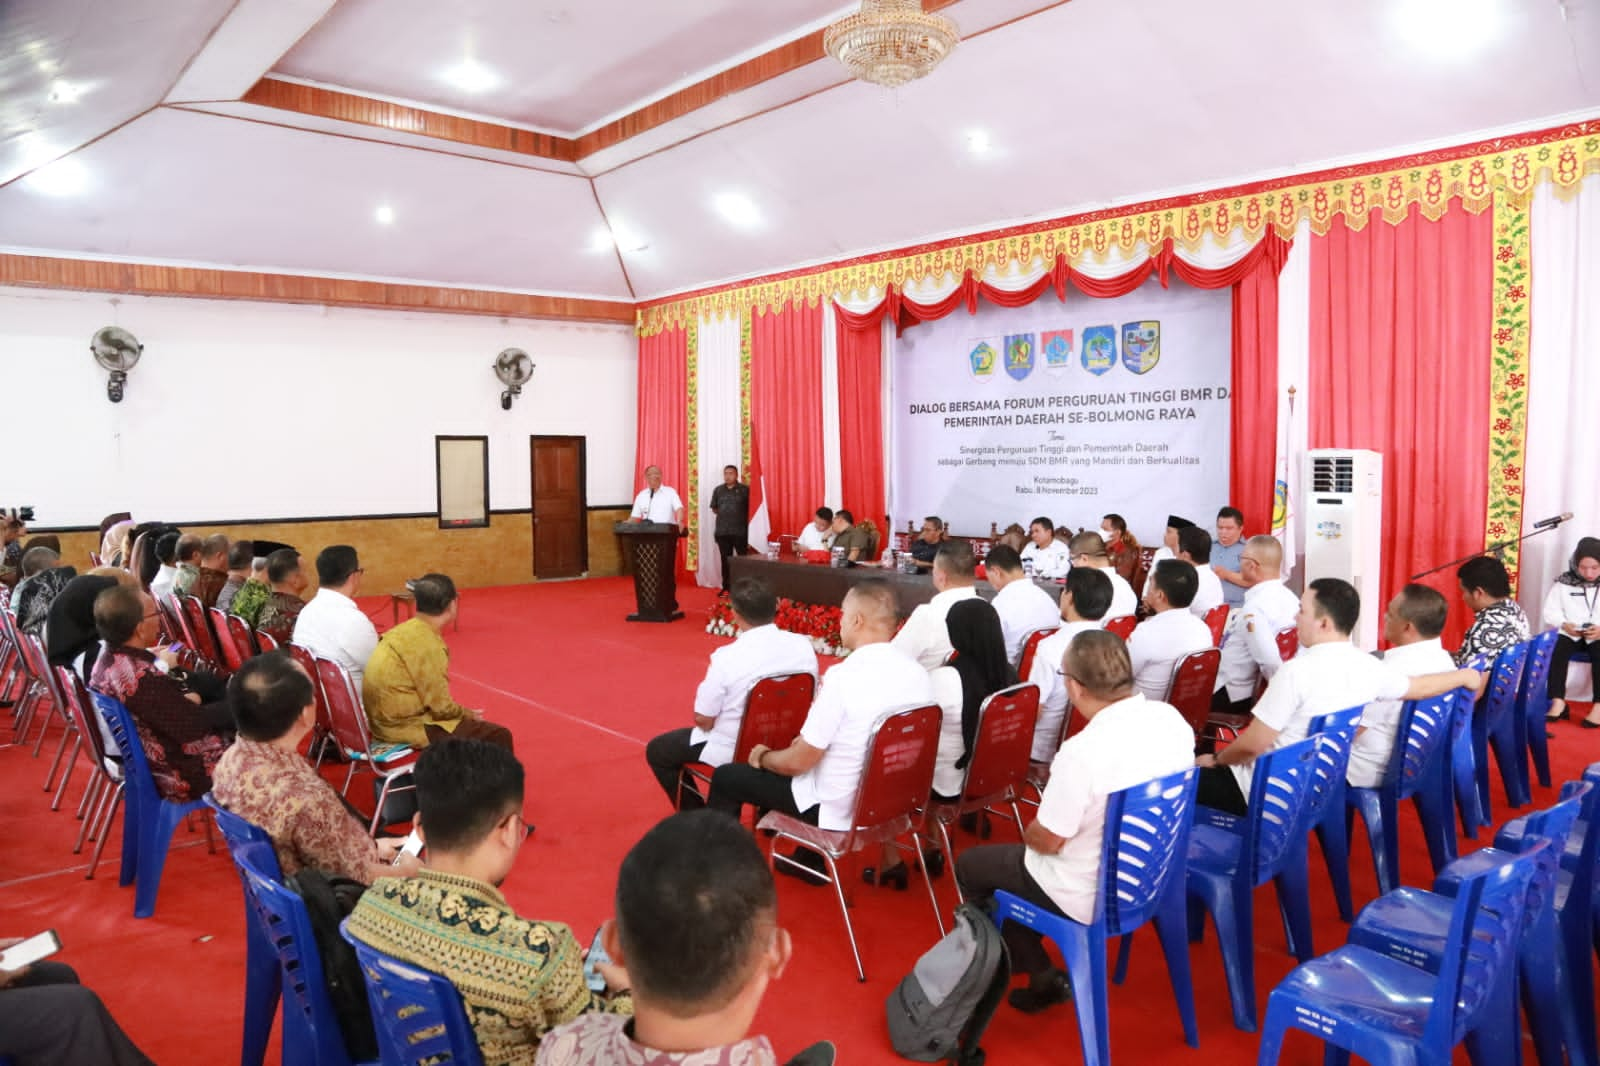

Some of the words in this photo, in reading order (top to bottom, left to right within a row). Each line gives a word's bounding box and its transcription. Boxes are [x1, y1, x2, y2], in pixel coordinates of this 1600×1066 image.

[909, 402, 947, 415] DIALOG
[949, 400, 1001, 413] BERSAMA
[1004, 397, 1045, 410] FORUM
[1048, 393, 1126, 408] PERGURUAN
[1130, 390, 1176, 403] TINGGI
[1181, 387, 1212, 401] BMR
[944, 415, 1012, 428] PEMERINTAH
[1015, 413, 1065, 425] DAERAH
[1068, 409, 1155, 423] SE-BOLMONG
[1159, 407, 1196, 420] RAYA
[960, 446, 995, 455] Sinergitas
[997, 446, 1037, 455] Perguruan
[1039, 444, 1064, 454] Tinggi
[1065, 444, 1081, 453] dan
[1083, 443, 1133, 453] Pemerintah
[1136, 443, 1169, 452] Daerah
[937, 458, 963, 467] sebagai
[965, 457, 996, 467] Gerbang
[1028, 457, 1047, 465] SDM
[1049, 457, 1067, 465] BMR
[1070, 457, 1090, 466] yang
[1092, 455, 1125, 465] Mandiri
[1127, 456, 1144, 465] dan
[1146, 455, 1200, 465] Berkualitas
[1033, 476, 1079, 486] Kotamobagu
[1041, 486, 1079, 495] November
[1079, 487, 1098, 495] 2023
